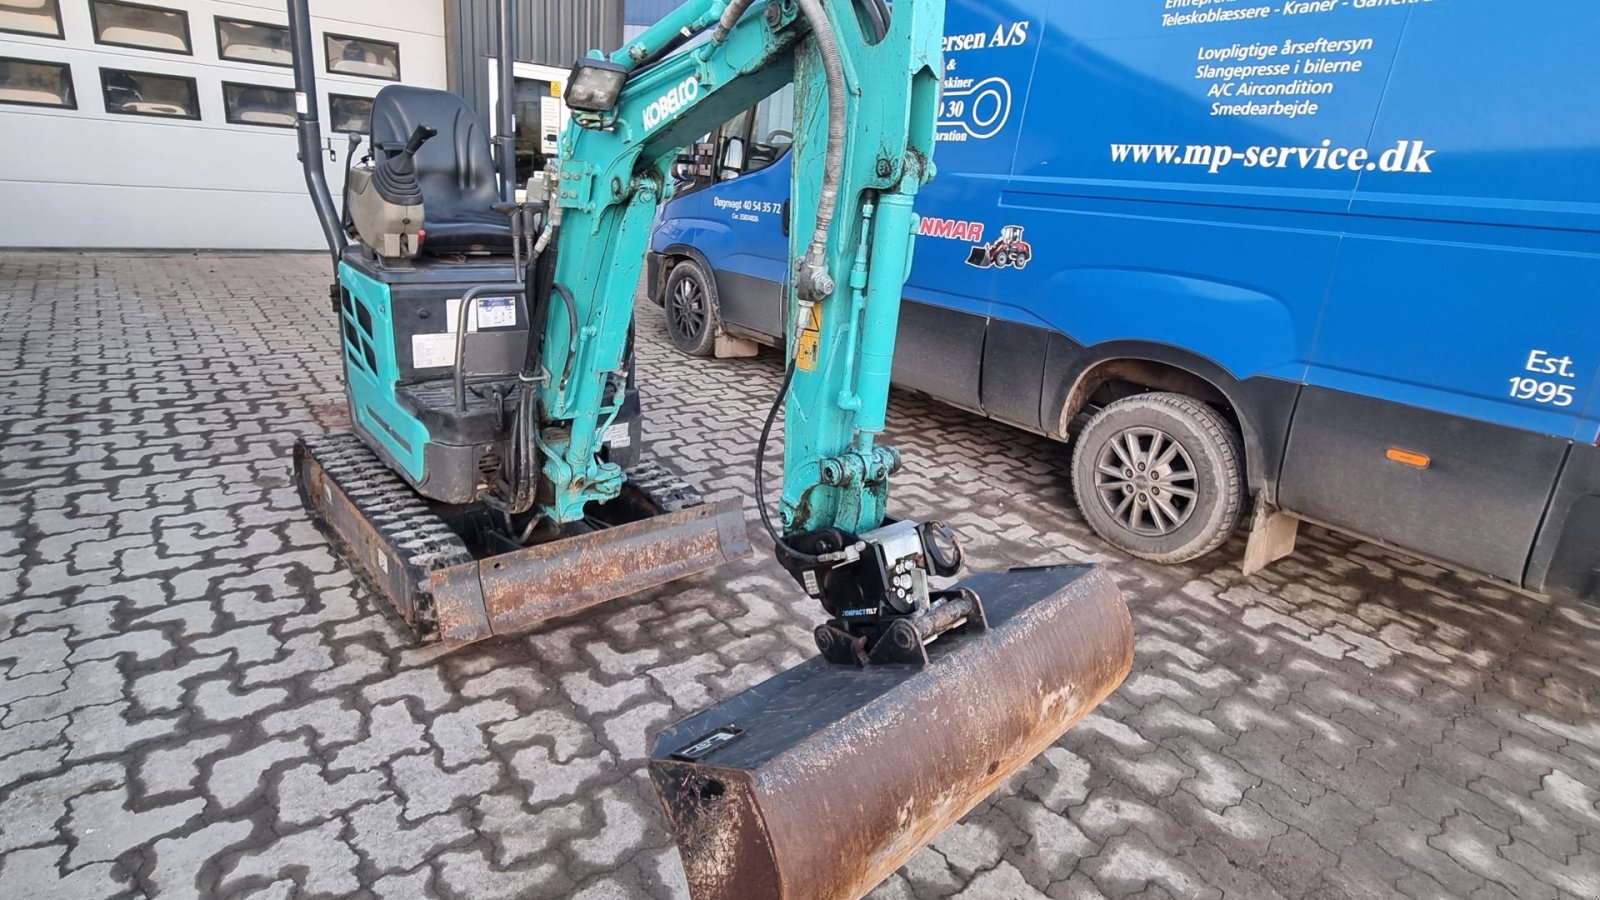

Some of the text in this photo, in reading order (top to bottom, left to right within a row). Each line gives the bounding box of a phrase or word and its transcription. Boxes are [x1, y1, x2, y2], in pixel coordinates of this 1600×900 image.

[1162, 6, 1271, 26] Teleskoblæssere
[1283, 0, 1337, 15] Kraner
[988, 21, 1029, 48] A/S
[1197, 36, 1373, 62] Lovpligtige årseftersyn
[946, 58, 956, 71] &
[1195, 58, 1362, 80] Slangepresse i bilerne
[1207, 80, 1333, 98] A/C Aircondition
[642, 76, 699, 132] KOBELCO
[945, 100, 965, 118] 30
[1210, 100, 1318, 118] Smedearbejde
[1110, 138, 1436, 174] www.mp-service.dk
[743, 199, 752, 210] 40
[752, 201, 761, 212] 54
[762, 202, 771, 213] 35
[772, 203, 782, 214] 72
[919, 217, 984, 242] NMAR
[1525, 349, 1575, 378] Est.
[1509, 376, 1576, 407] 1995
